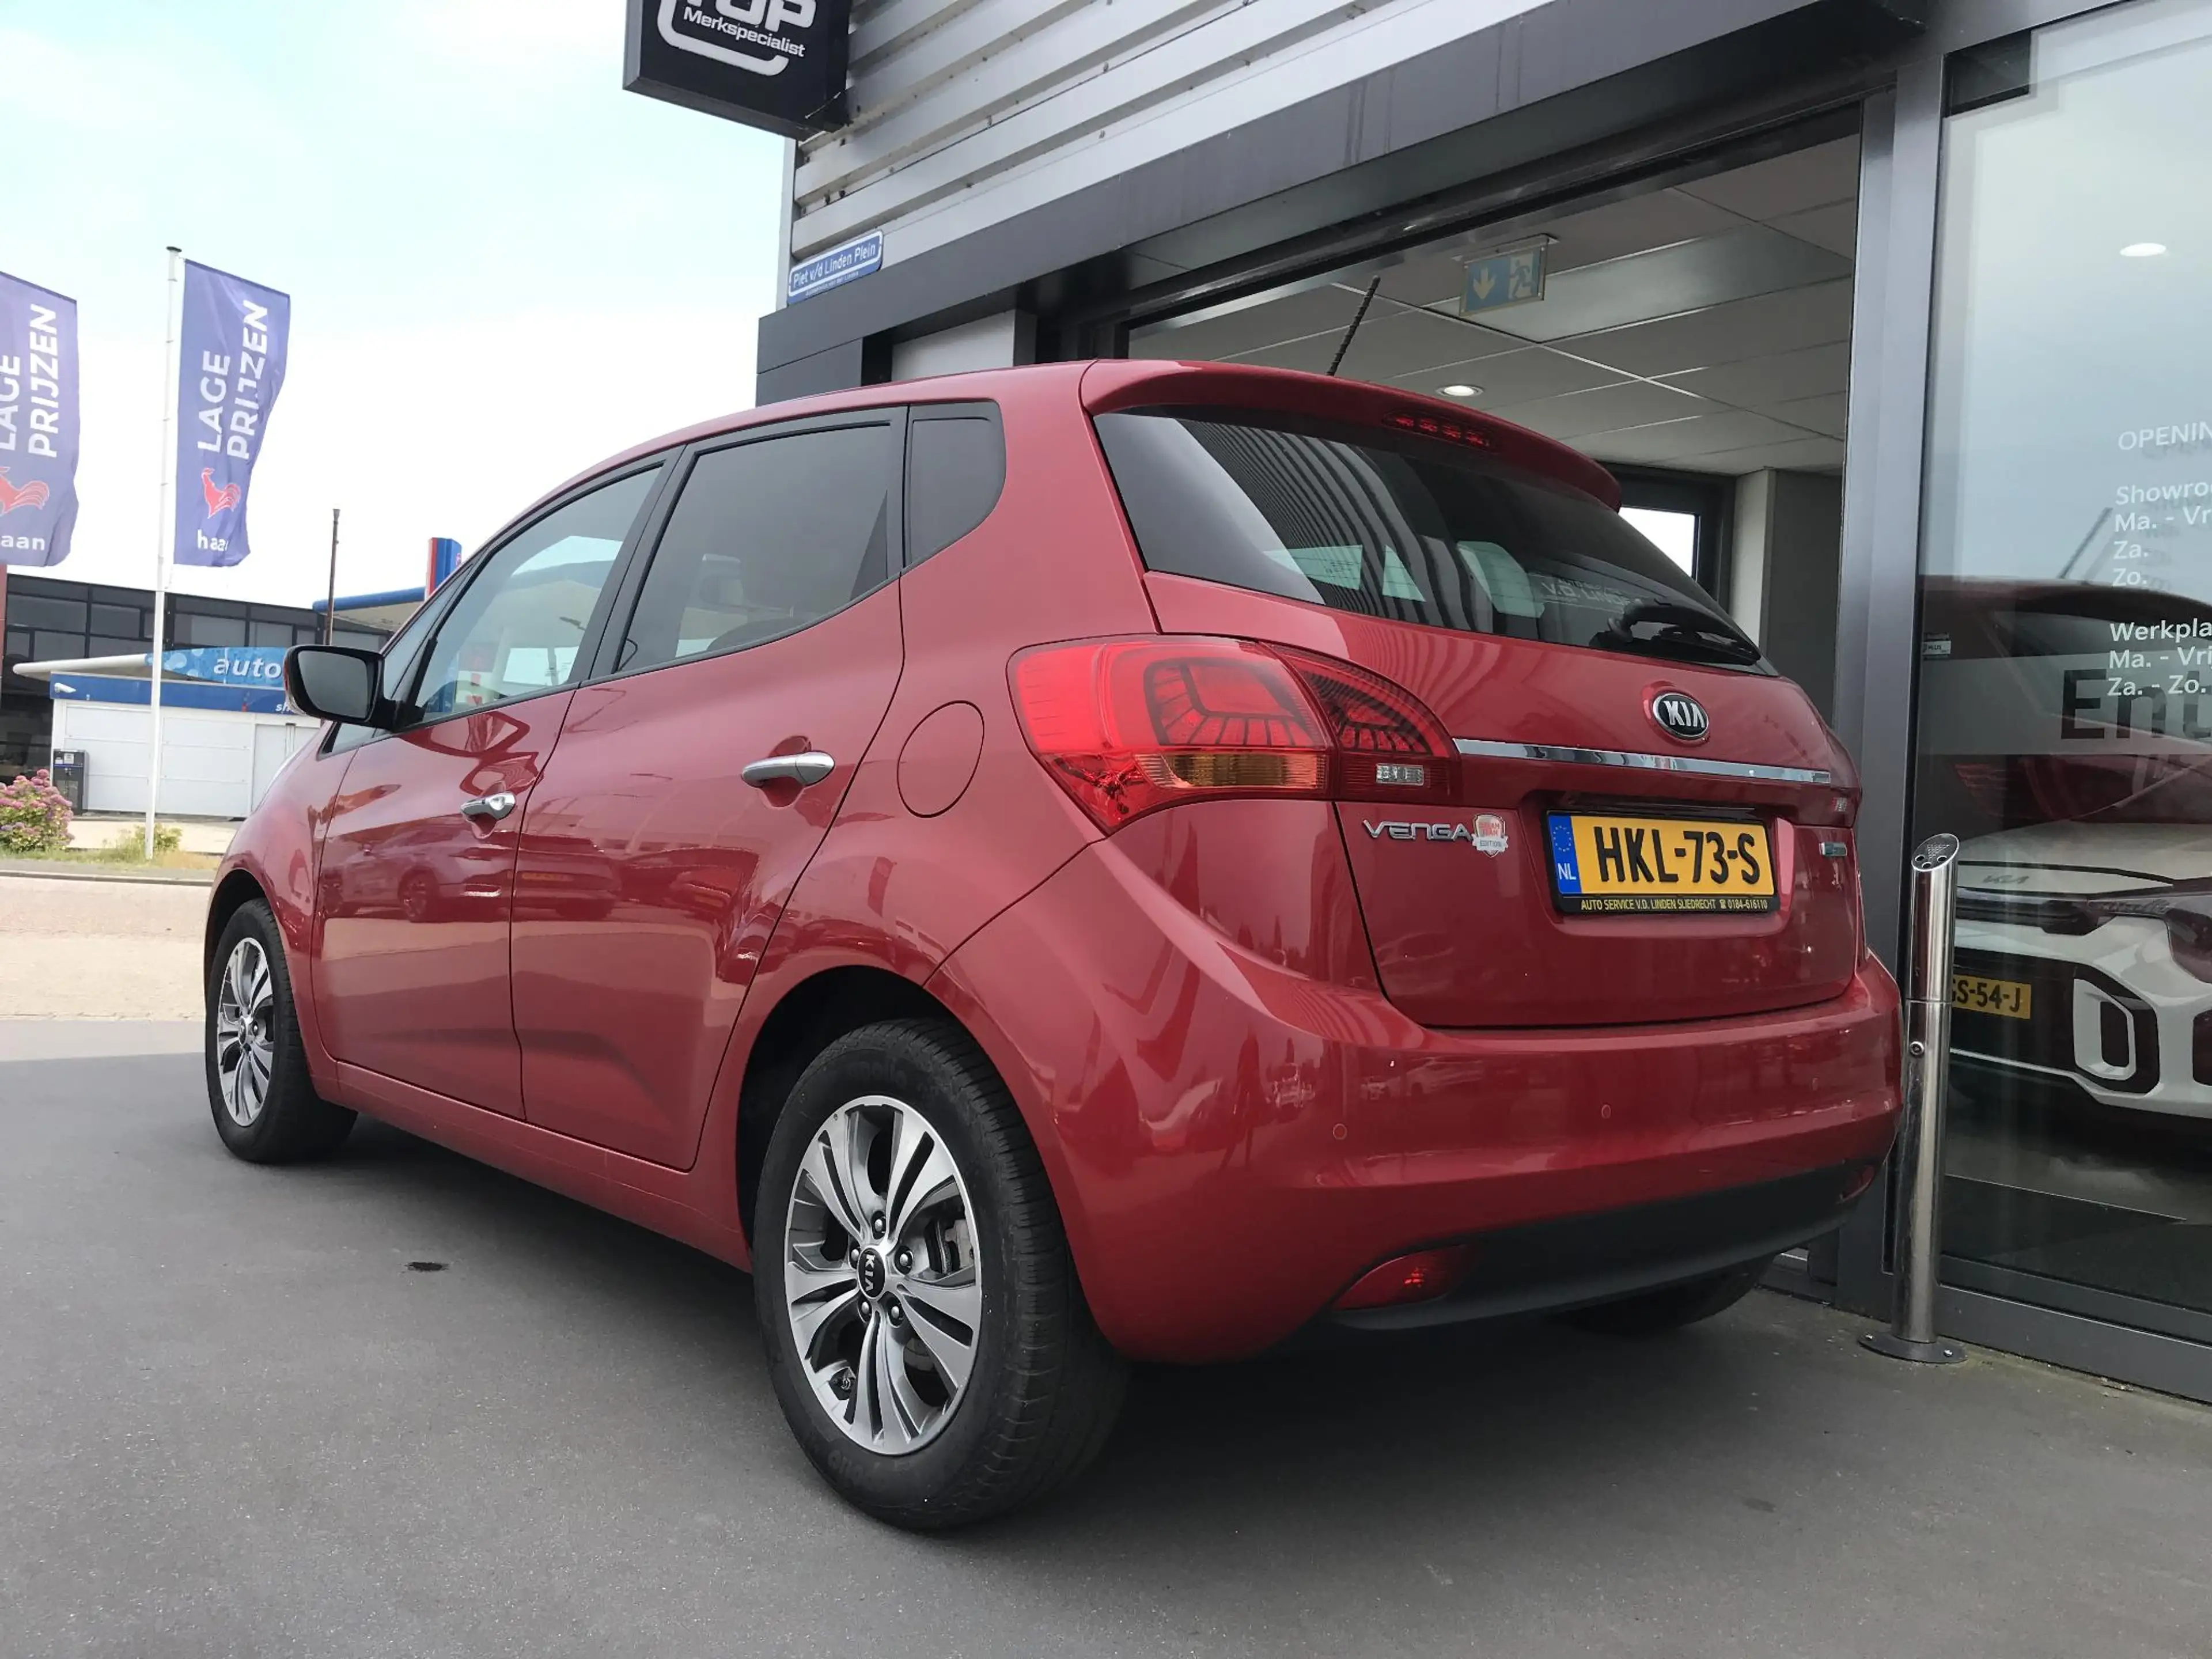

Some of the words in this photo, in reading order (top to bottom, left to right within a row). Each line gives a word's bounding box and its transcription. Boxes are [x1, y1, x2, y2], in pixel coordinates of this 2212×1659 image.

[683, 6, 806, 57] Merkspecialist
[793, 269, 808, 288] Piet
[824, 253, 853, 275] Linden
[854, 241, 876, 263] Plein
[29, 304, 59, 458] PRIJZEN
[198, 350, 230, 453] LAGE
[2115, 482, 2212, 505] Showro
[2115, 512, 2157, 532] Ma.
[2113, 540, 2149, 560] Za.
[2112, 568, 2147, 588] Zo.
[2108, 650, 2152, 668] Ma.
[2107, 677, 2143, 696] Za.
[2168, 675, 2206, 694] Zo.
[1663, 700, 1706, 728] KIA
[1362, 819, 1473, 842] VENGA
[1594, 825, 1760, 885] HKL-73-S
[1558, 862, 1576, 881] NL
[1581, 899, 1603, 911] AUTO
[1603, 899, 1635, 910] SERVICE
[1635, 899, 1650, 910] V.D.
[1650, 899, 1677, 910] LINDEN
[1677, 899, 1716, 910] SLIEDRECHT
[864, 1254, 876, 1292] KIA
